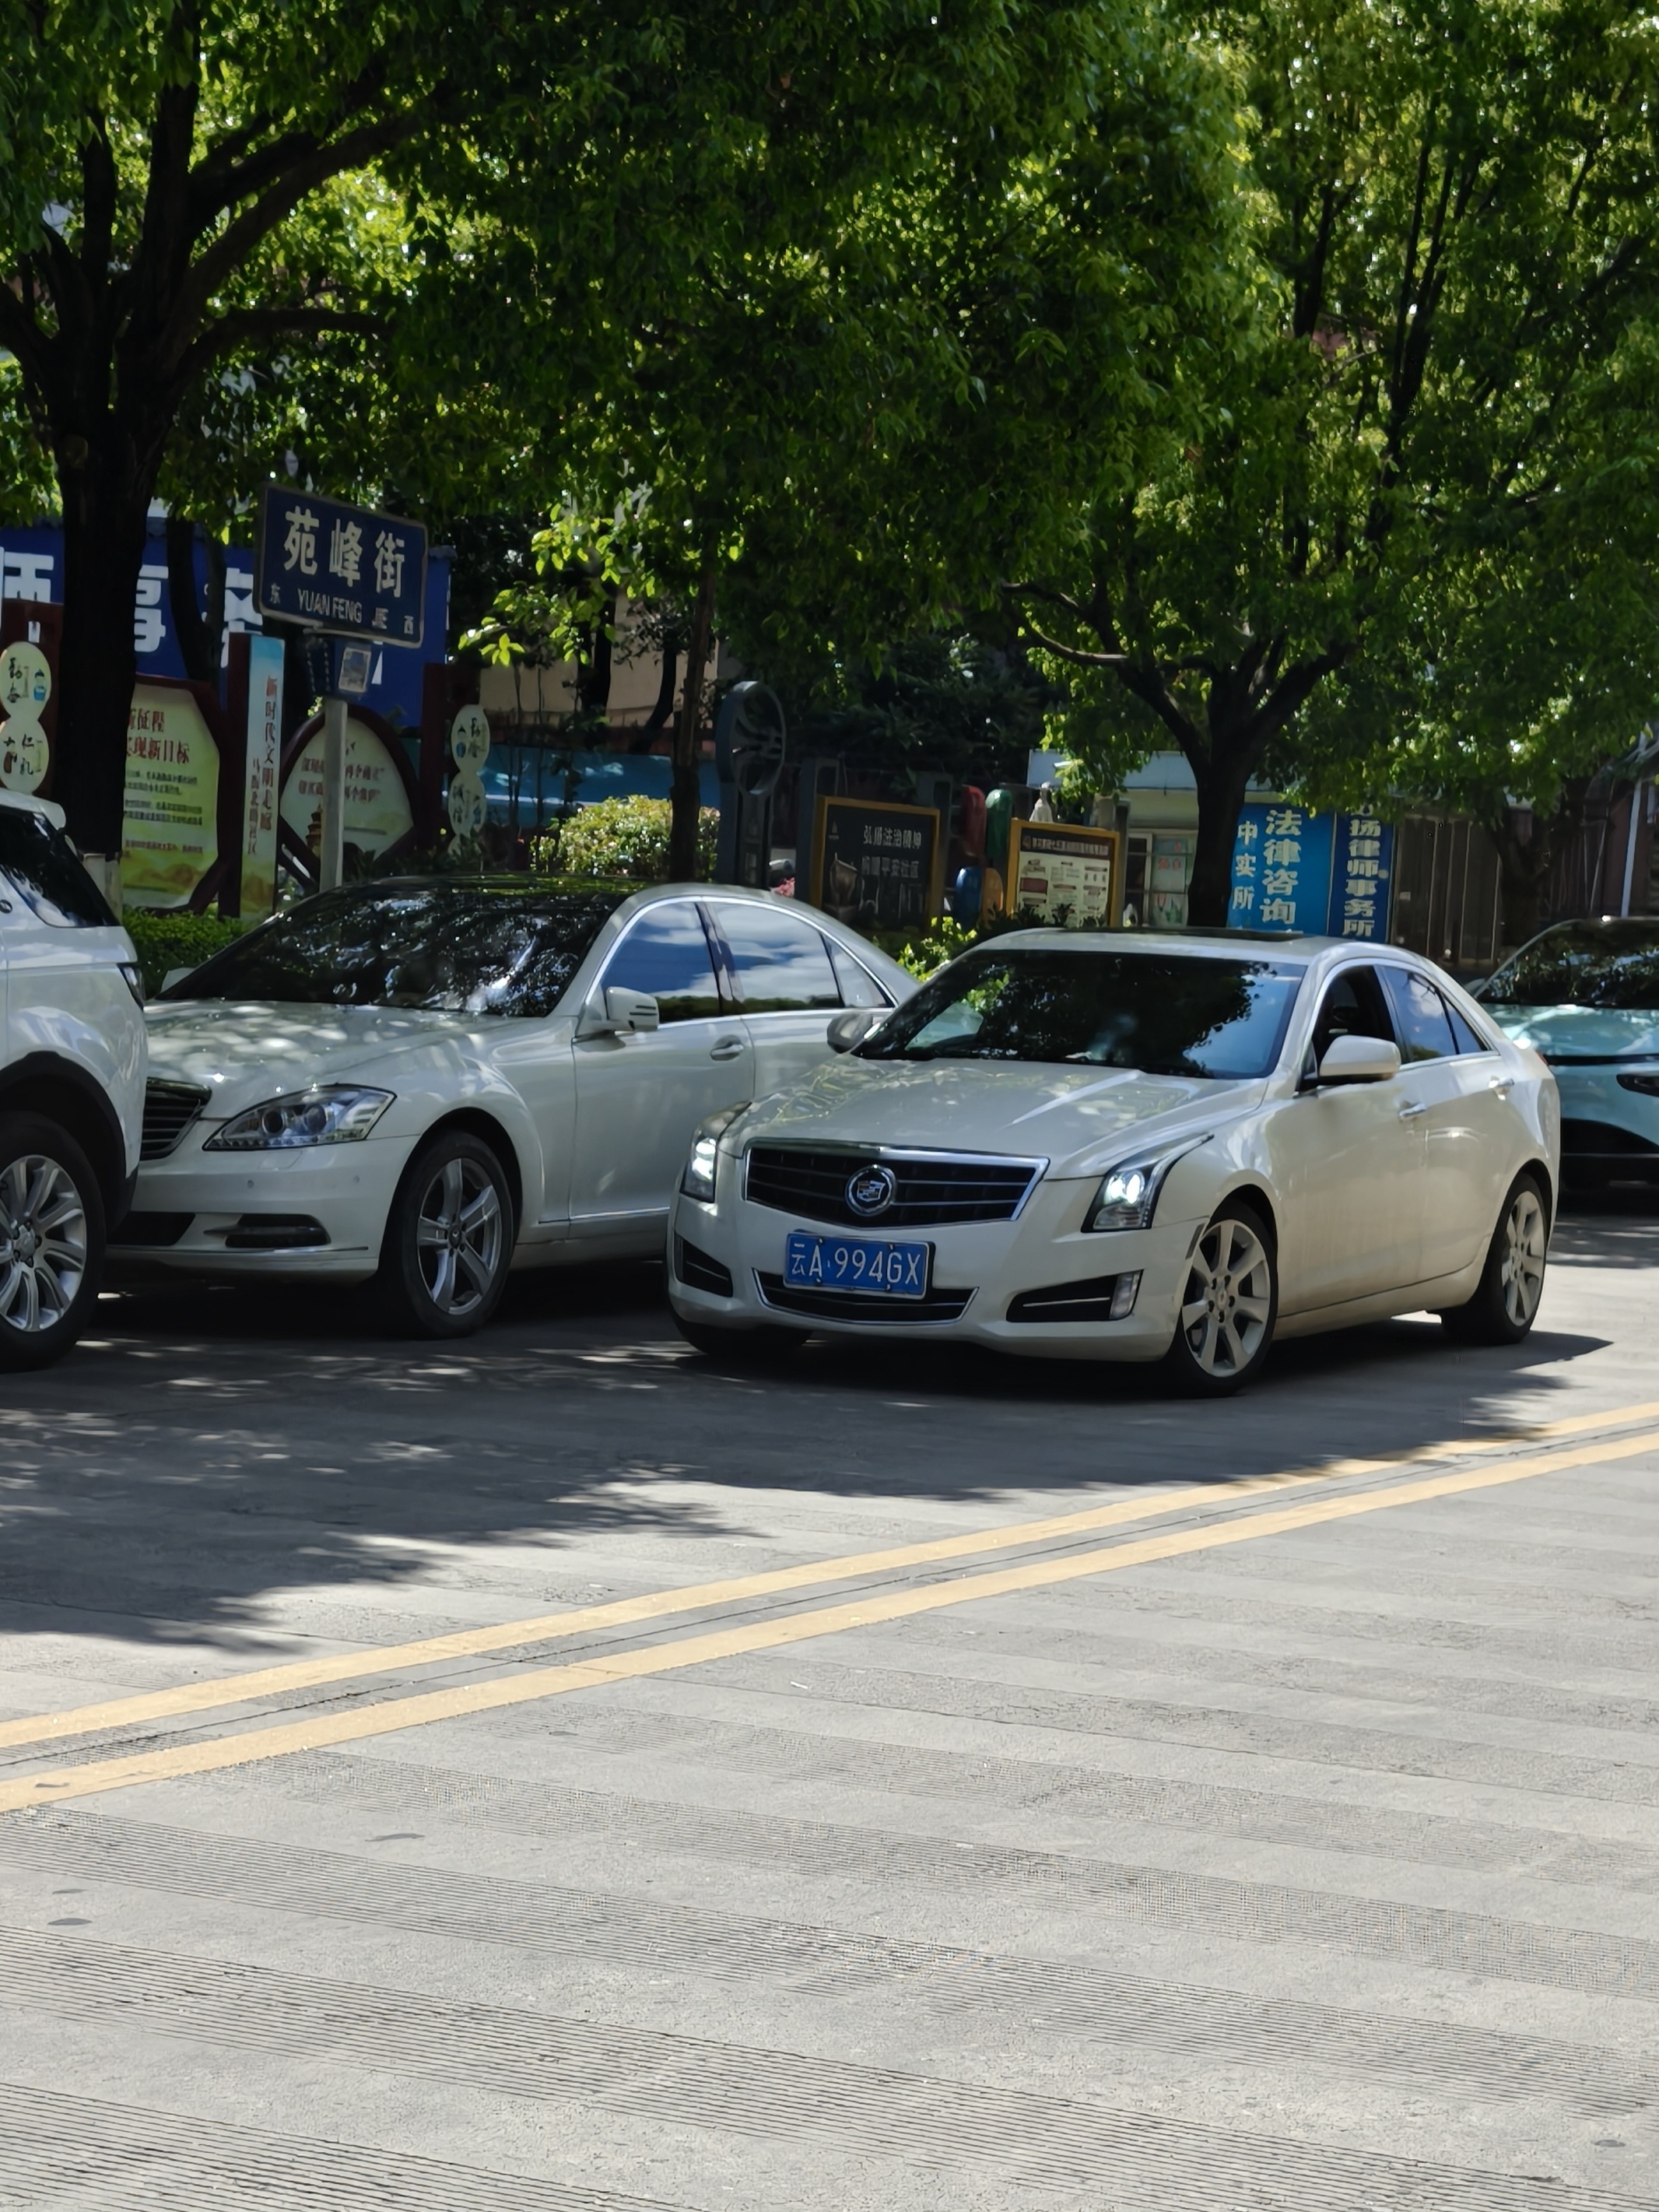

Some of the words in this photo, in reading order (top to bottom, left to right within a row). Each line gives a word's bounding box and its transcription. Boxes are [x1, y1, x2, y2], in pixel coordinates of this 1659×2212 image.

[283, 505, 405, 599] 苑峰街
[403, 615, 414, 634] 西
[127, 736, 189, 764] 现新目标
[1259, 809, 1303, 932] 法律咨询
